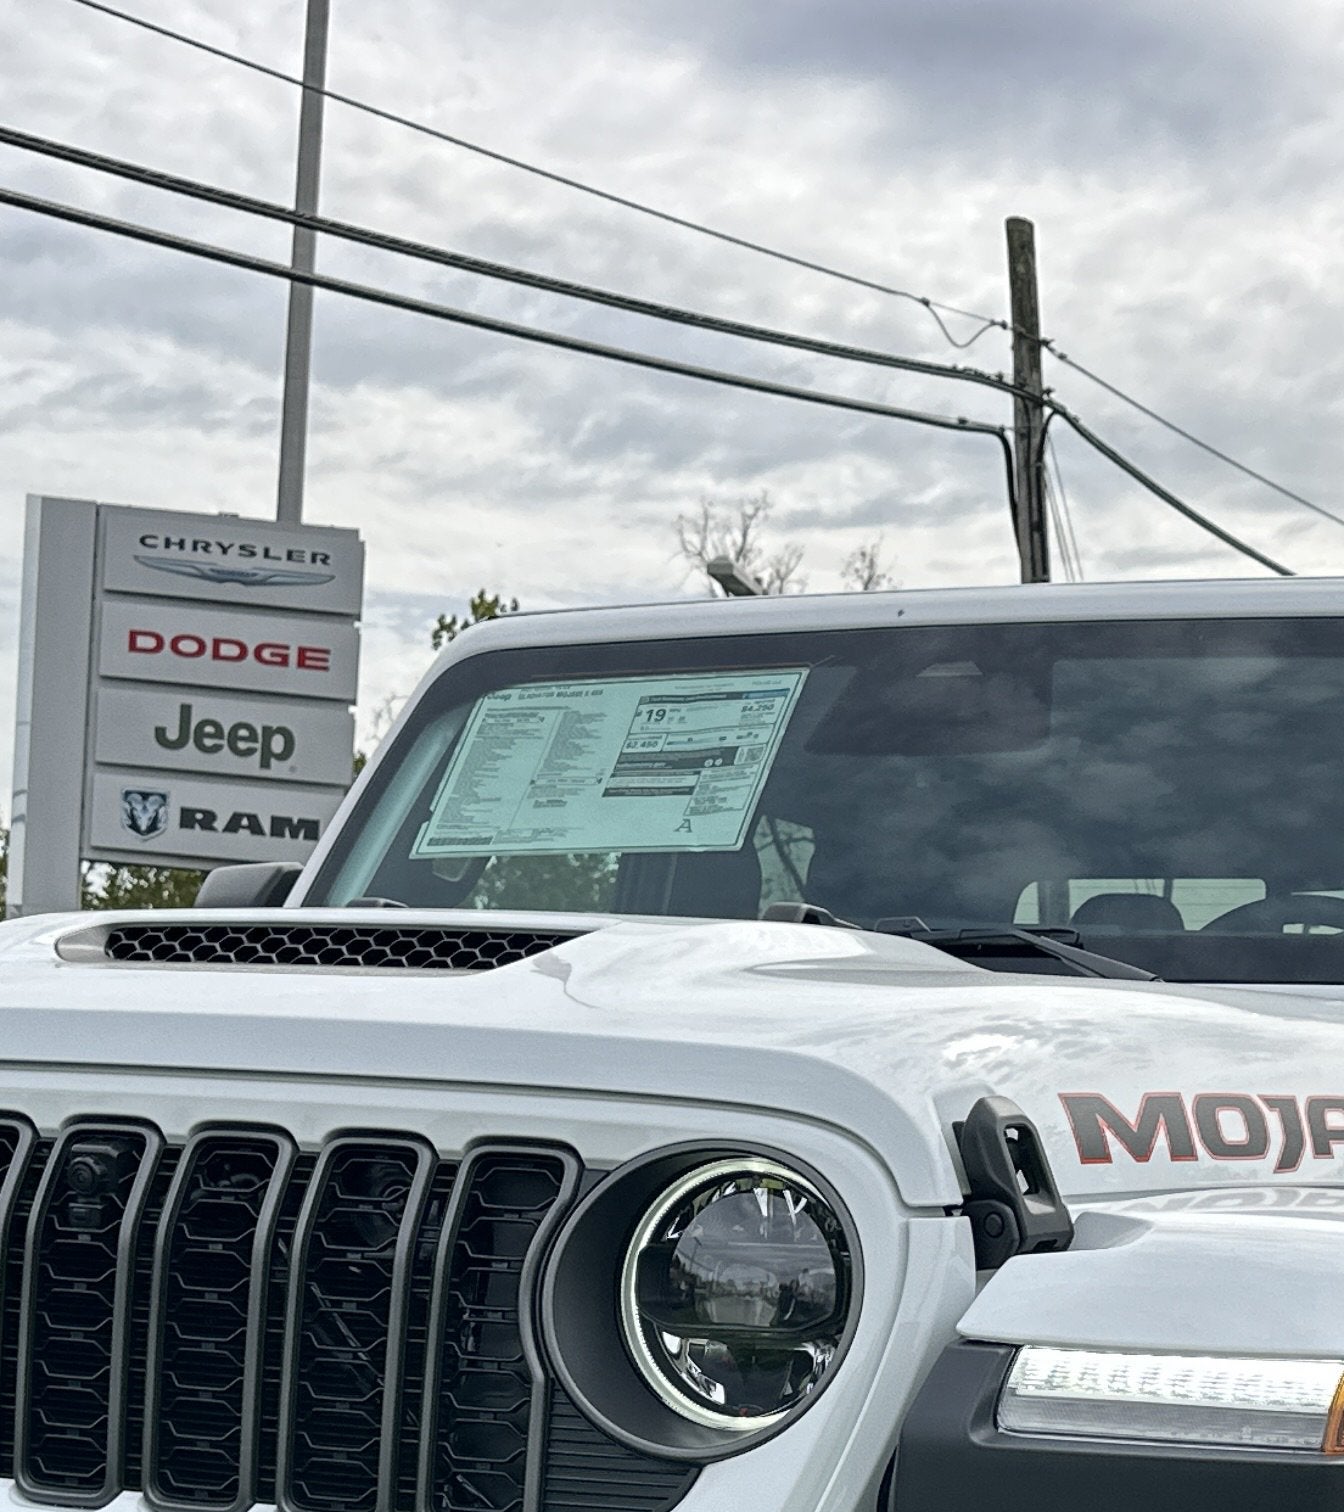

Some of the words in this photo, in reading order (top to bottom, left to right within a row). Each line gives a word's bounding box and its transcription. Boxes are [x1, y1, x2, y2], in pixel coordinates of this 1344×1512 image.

[138, 534, 332, 566] CHRYSLER
[127, 629, 332, 671] DODGE
[645, 708, 667, 723] 19
[154, 703, 296, 770] Jeep
[178, 806, 321, 842] RAM
